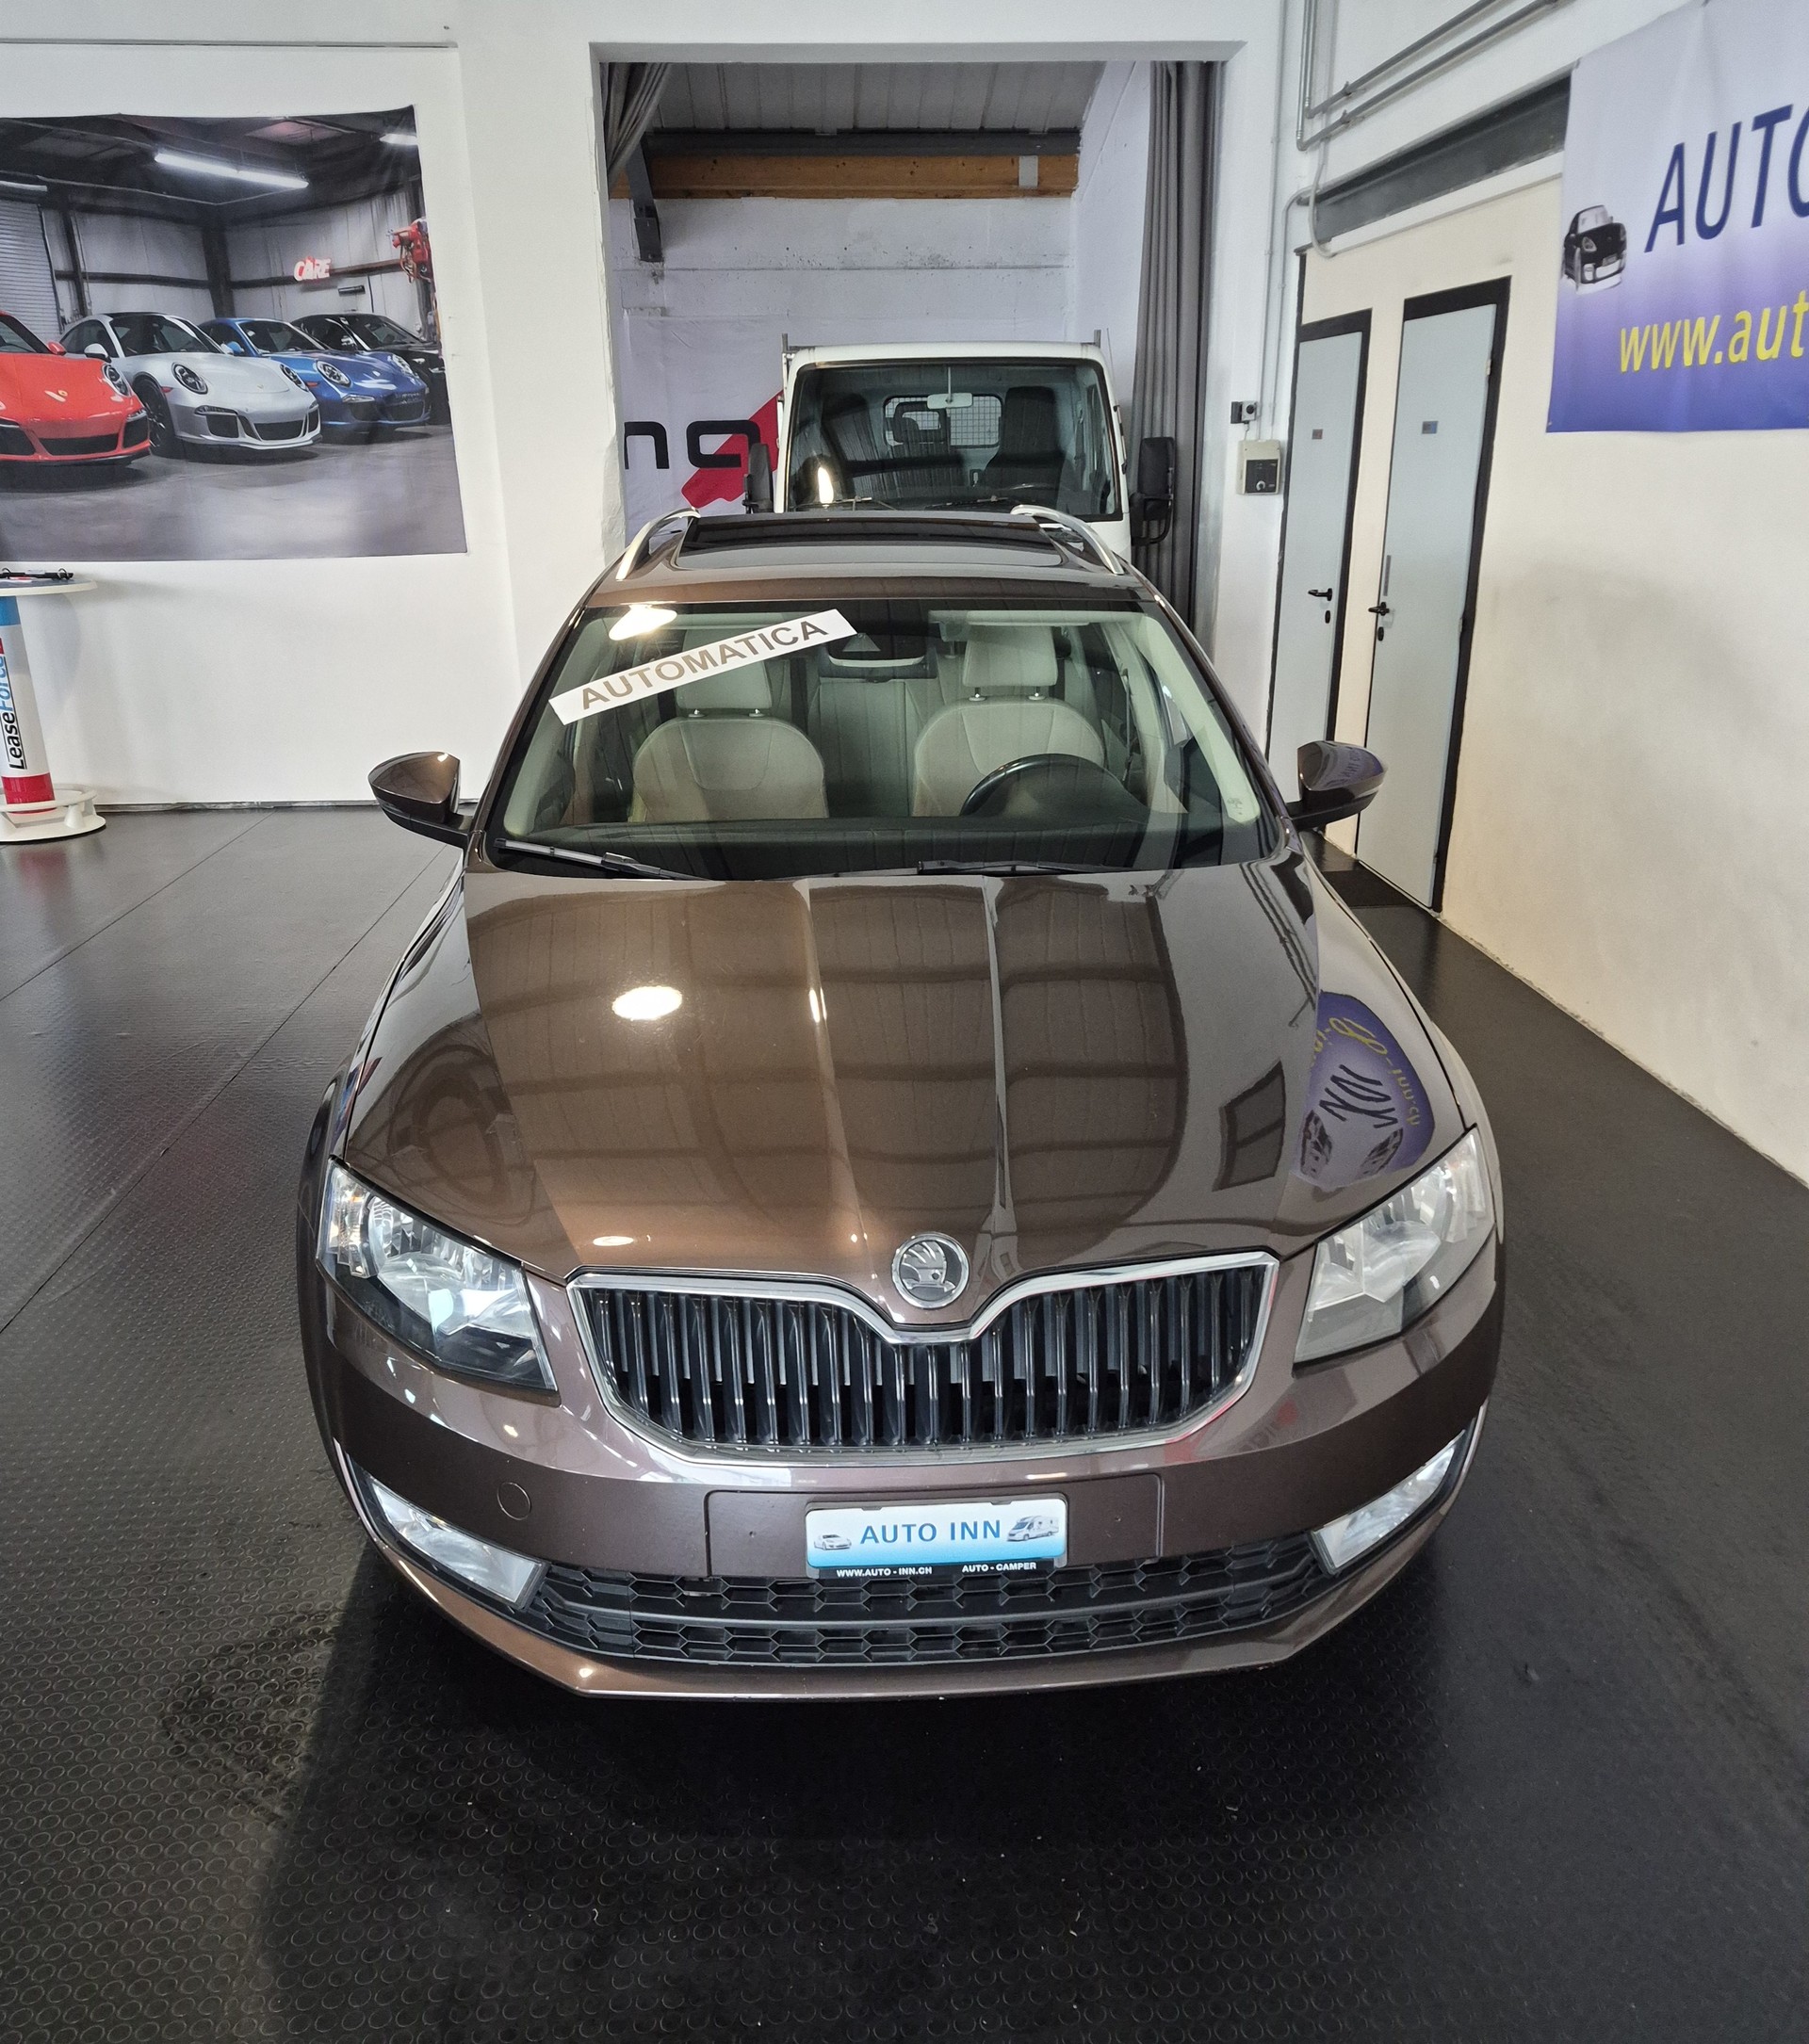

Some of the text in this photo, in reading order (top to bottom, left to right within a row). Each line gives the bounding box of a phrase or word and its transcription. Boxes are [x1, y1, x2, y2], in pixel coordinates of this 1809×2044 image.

[581, 621, 828, 710] AUTOMATICA
[860, 1519, 1001, 1545] AUTO INN
[962, 1564, 988, 1573] AUTO
[996, 1562, 1036, 1571] CAMPER
